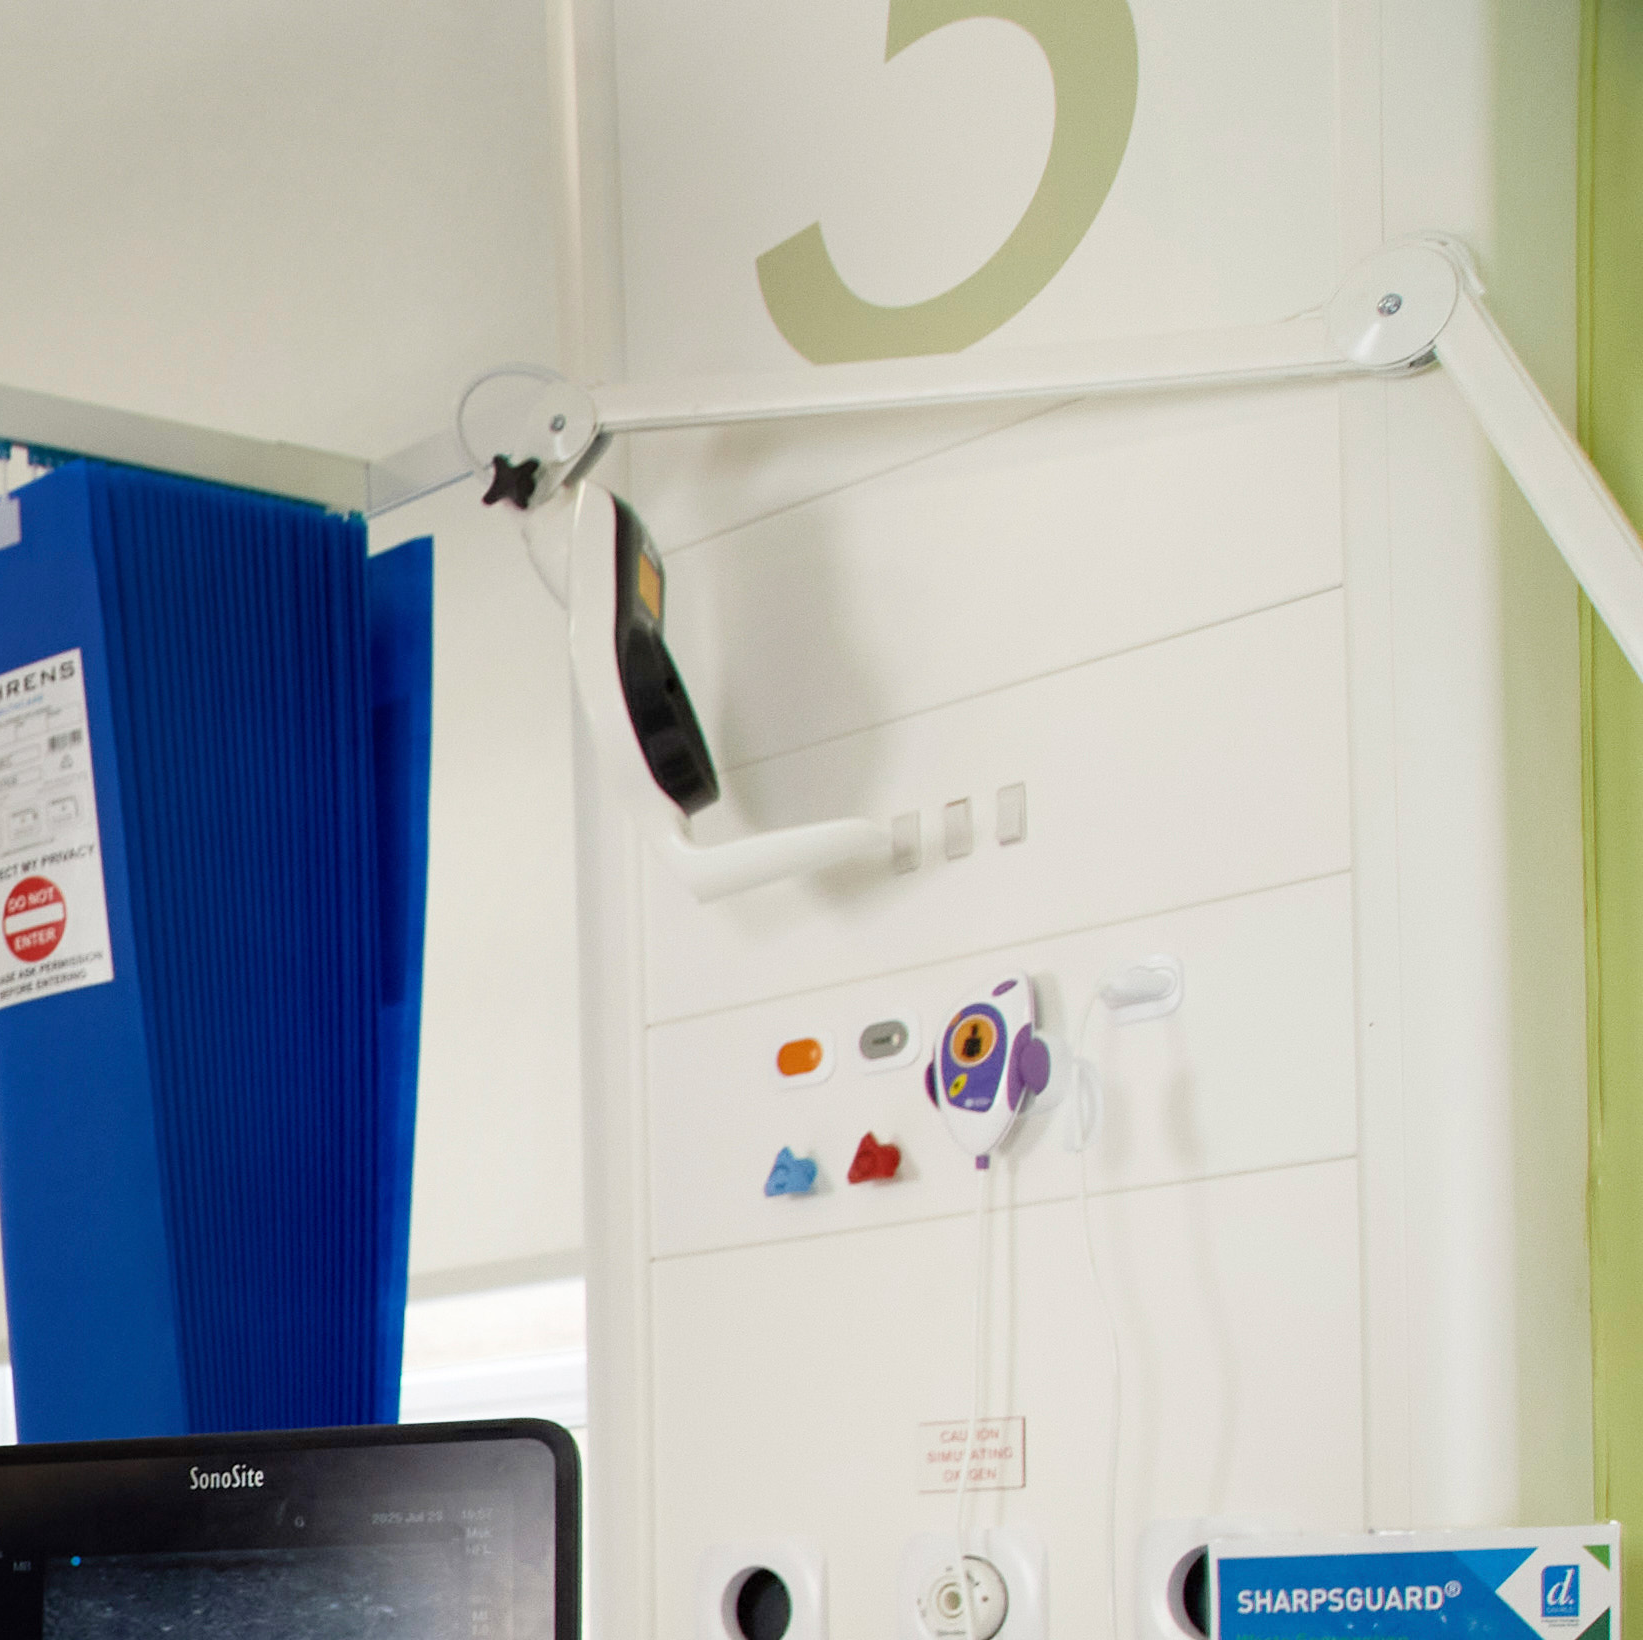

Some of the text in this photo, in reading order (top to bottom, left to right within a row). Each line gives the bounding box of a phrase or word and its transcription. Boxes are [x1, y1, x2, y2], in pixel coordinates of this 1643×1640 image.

[41, 844, 95, 864] PRIVACY
[8, 886, 55, 913] DO NOT
[16, 926, 57, 952] ENTER
[939, 1427, 999, 1444] CAUION
[926, 1446, 1013, 1464] SIMUATING
[190, 1466, 264, 1490] SonoSite
[943, 1467, 997, 1483] OXGEN
